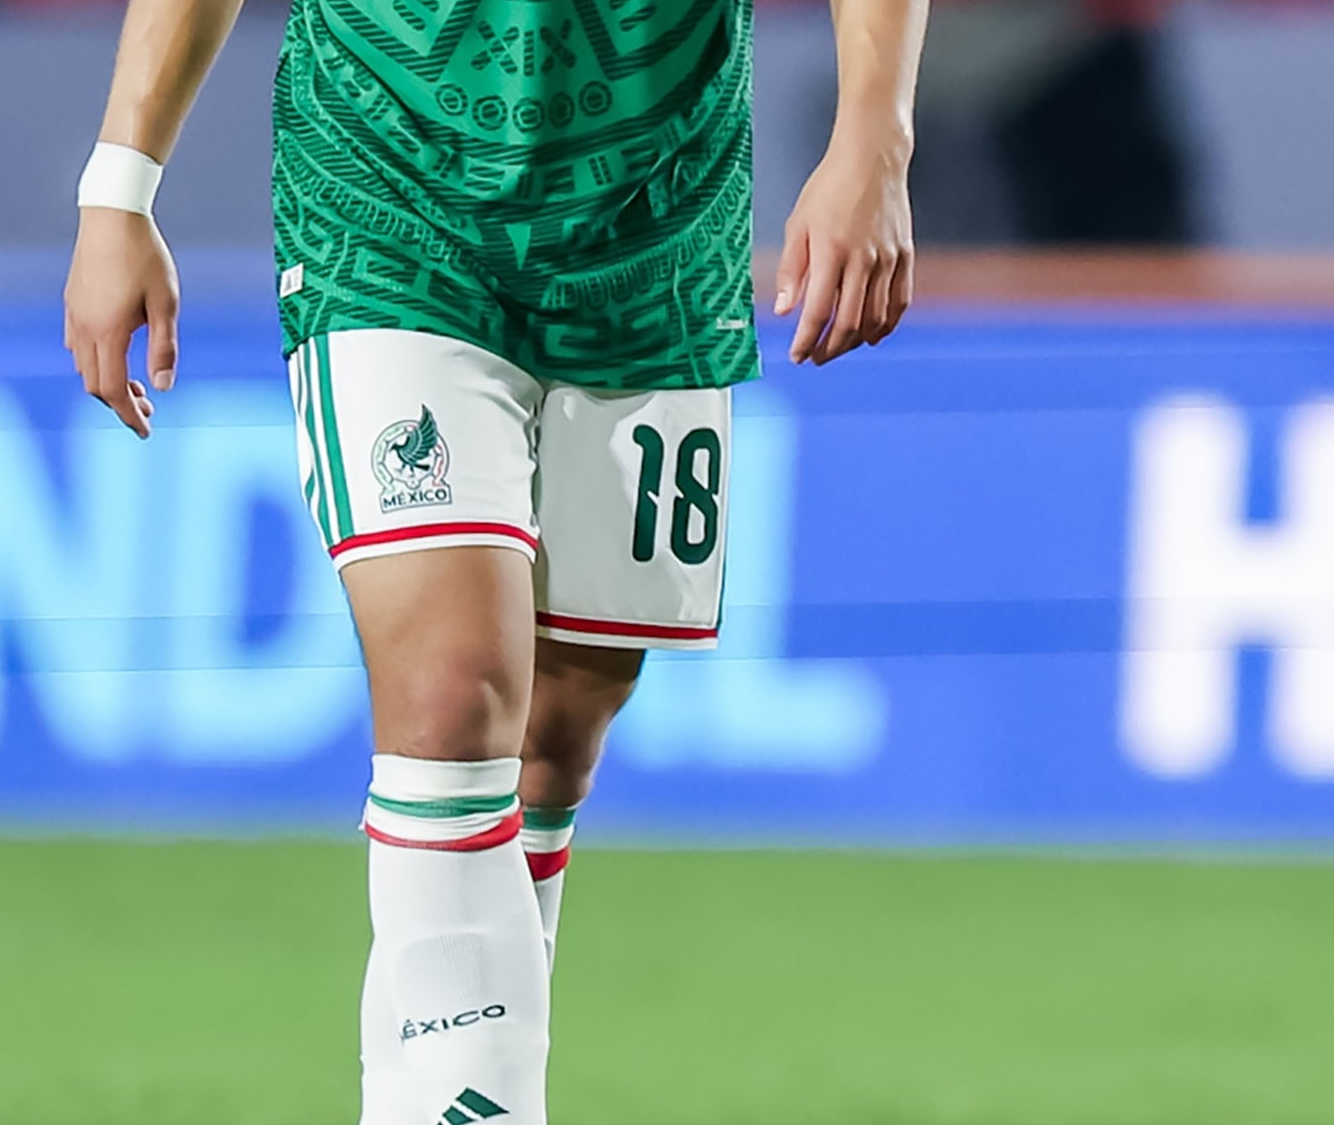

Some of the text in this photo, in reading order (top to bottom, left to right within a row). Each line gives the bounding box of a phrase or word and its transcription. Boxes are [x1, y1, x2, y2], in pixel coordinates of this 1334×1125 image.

[383, 488, 447, 508] MÉXICO
[632, 424, 721, 565] 18
[400, 1004, 506, 1044] ÉXICO
